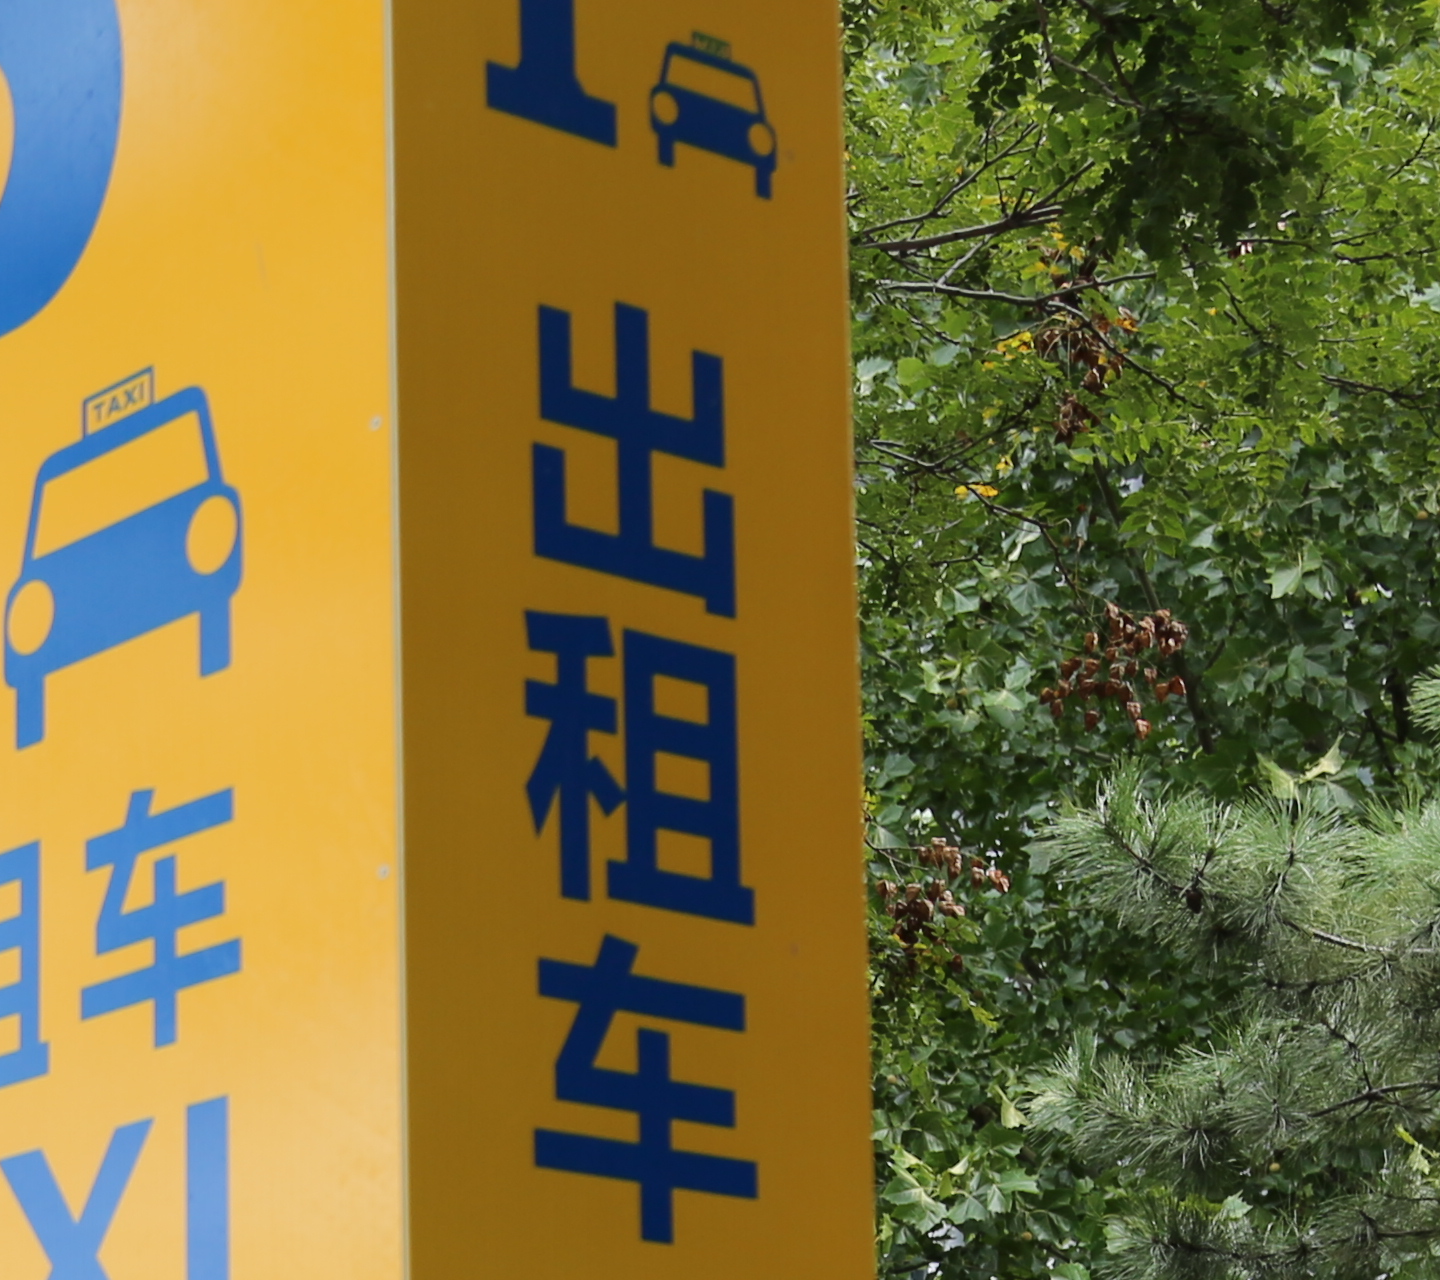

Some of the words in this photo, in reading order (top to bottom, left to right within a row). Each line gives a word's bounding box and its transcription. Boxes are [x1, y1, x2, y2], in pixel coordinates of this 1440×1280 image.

[92, 381, 146, 424] TAXI
[524, 300, 759, 1246] 出租车
